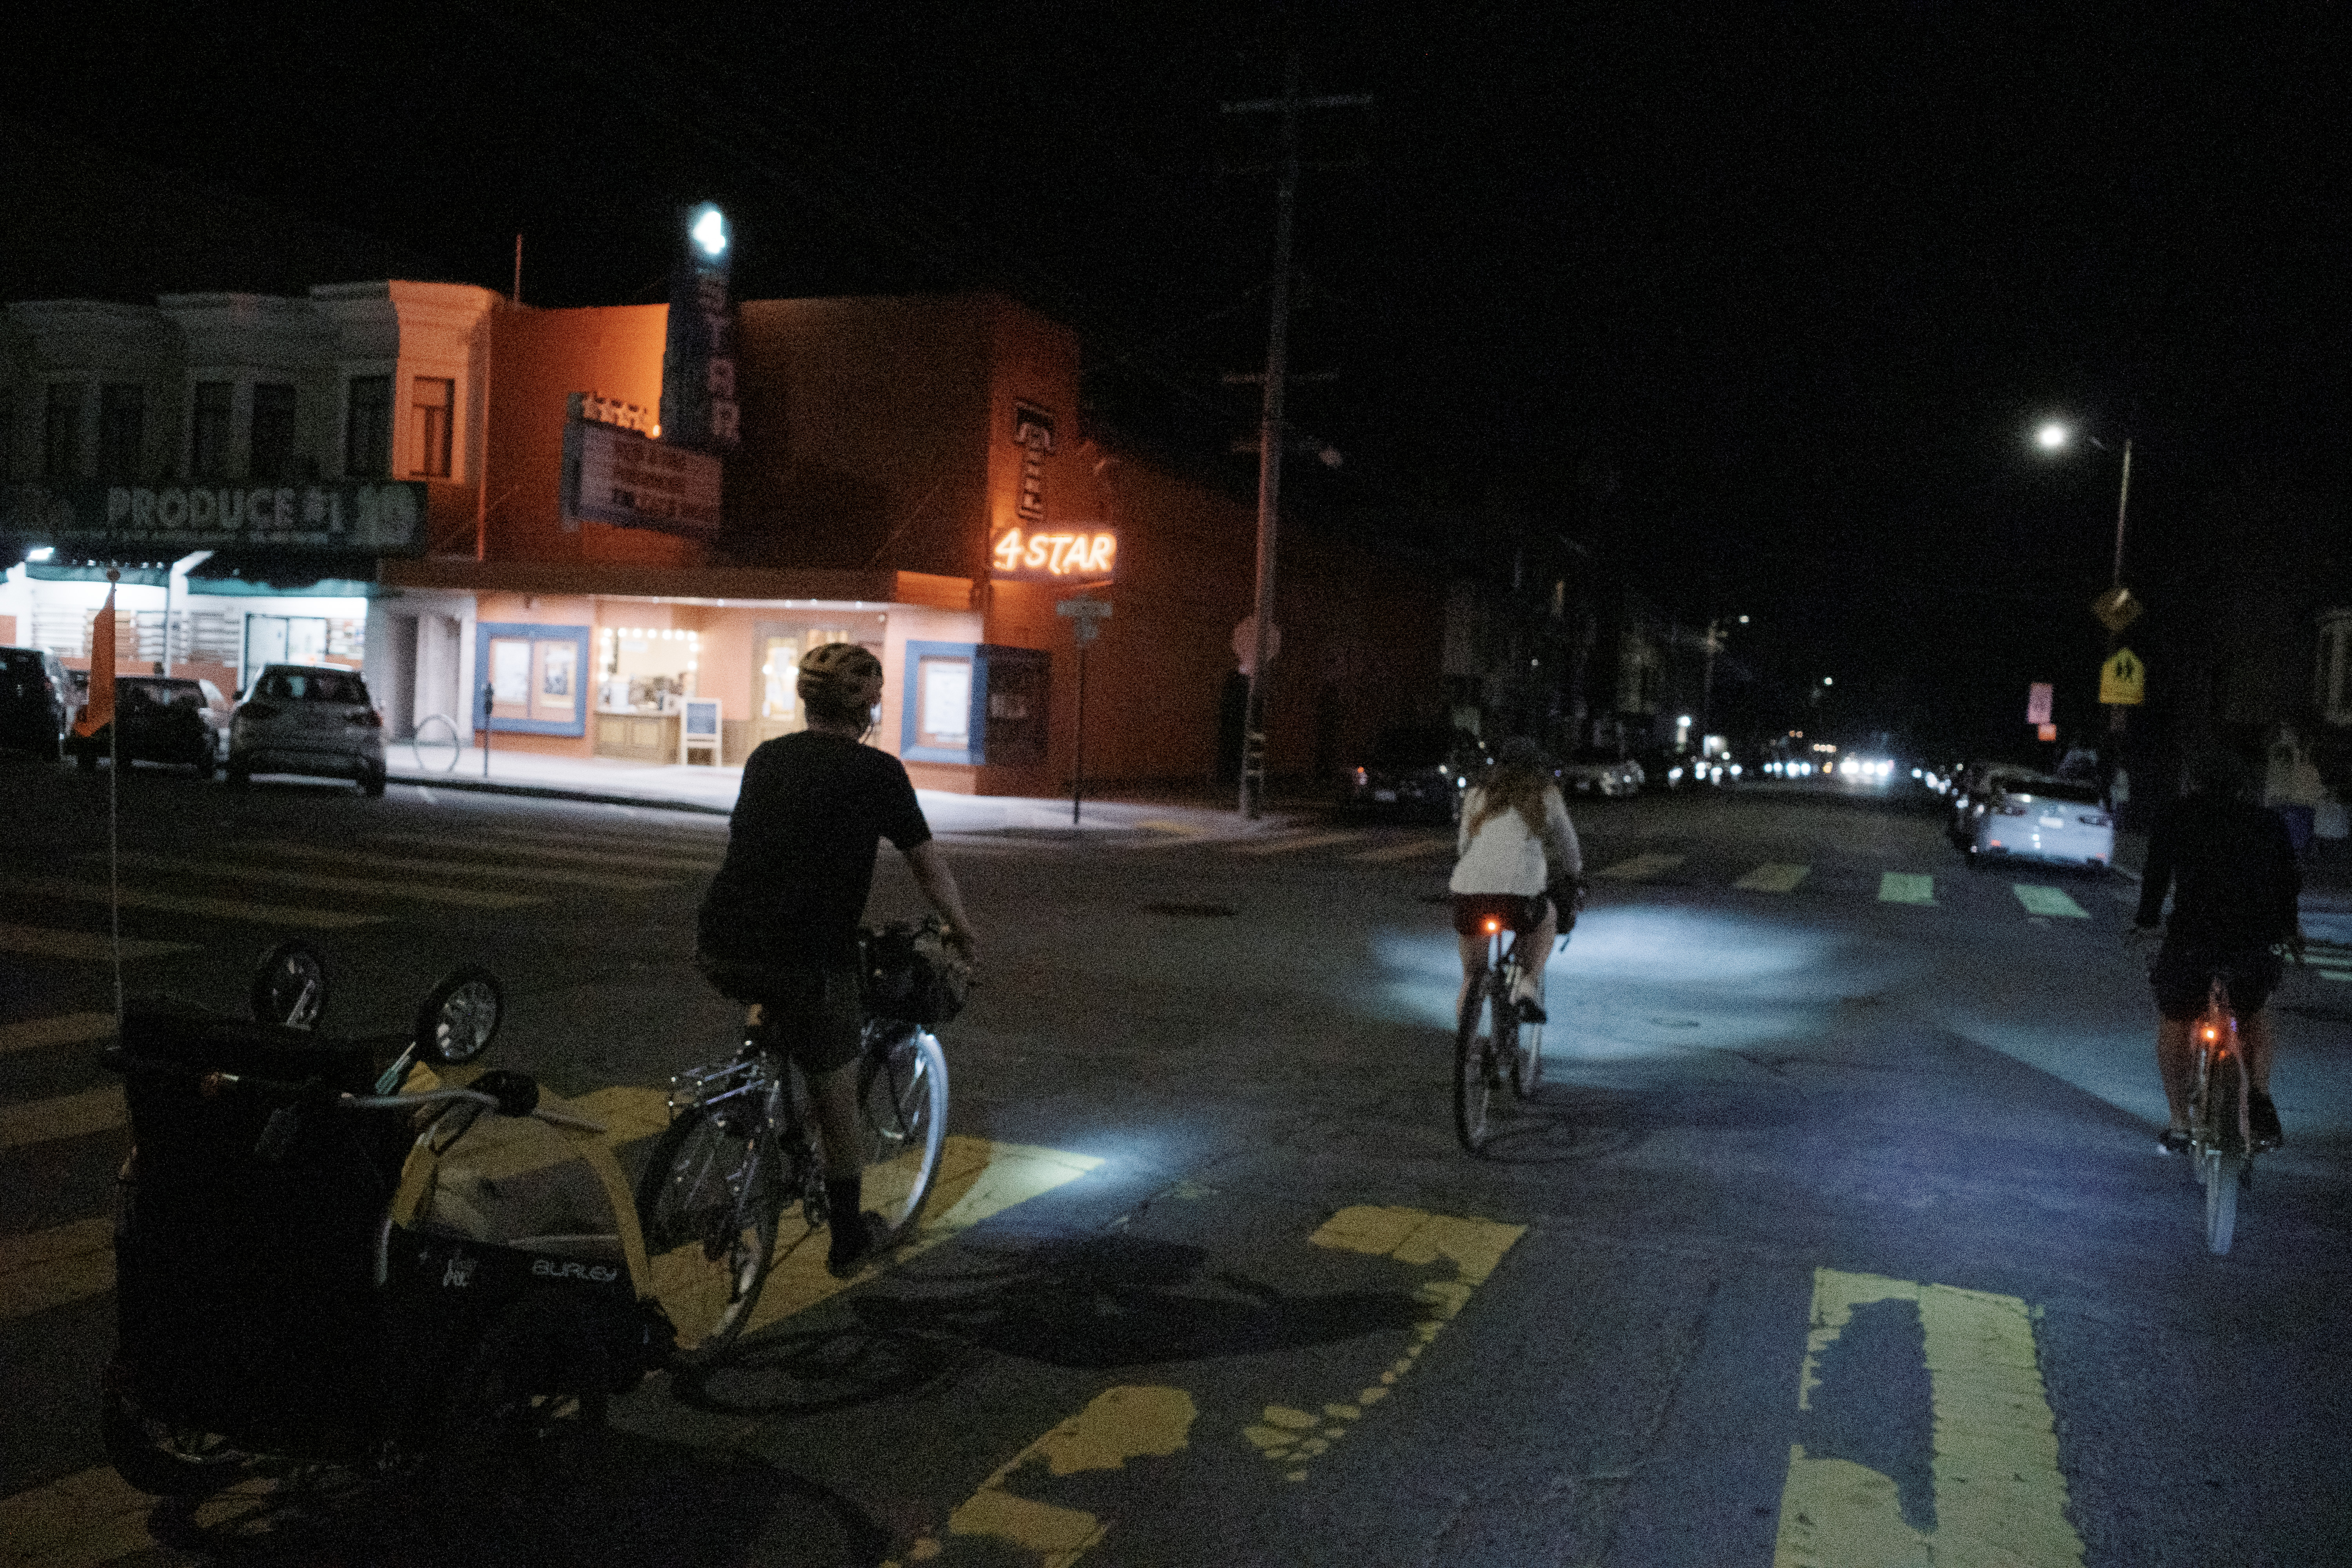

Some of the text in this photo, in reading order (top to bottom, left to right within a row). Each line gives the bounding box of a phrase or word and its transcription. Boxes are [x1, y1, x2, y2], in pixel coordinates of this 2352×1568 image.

[693, 211, 740, 442] 4 STAR
[107, 486, 294, 530] PRODUCE
[993, 528, 1116, 575] 4 STAR
